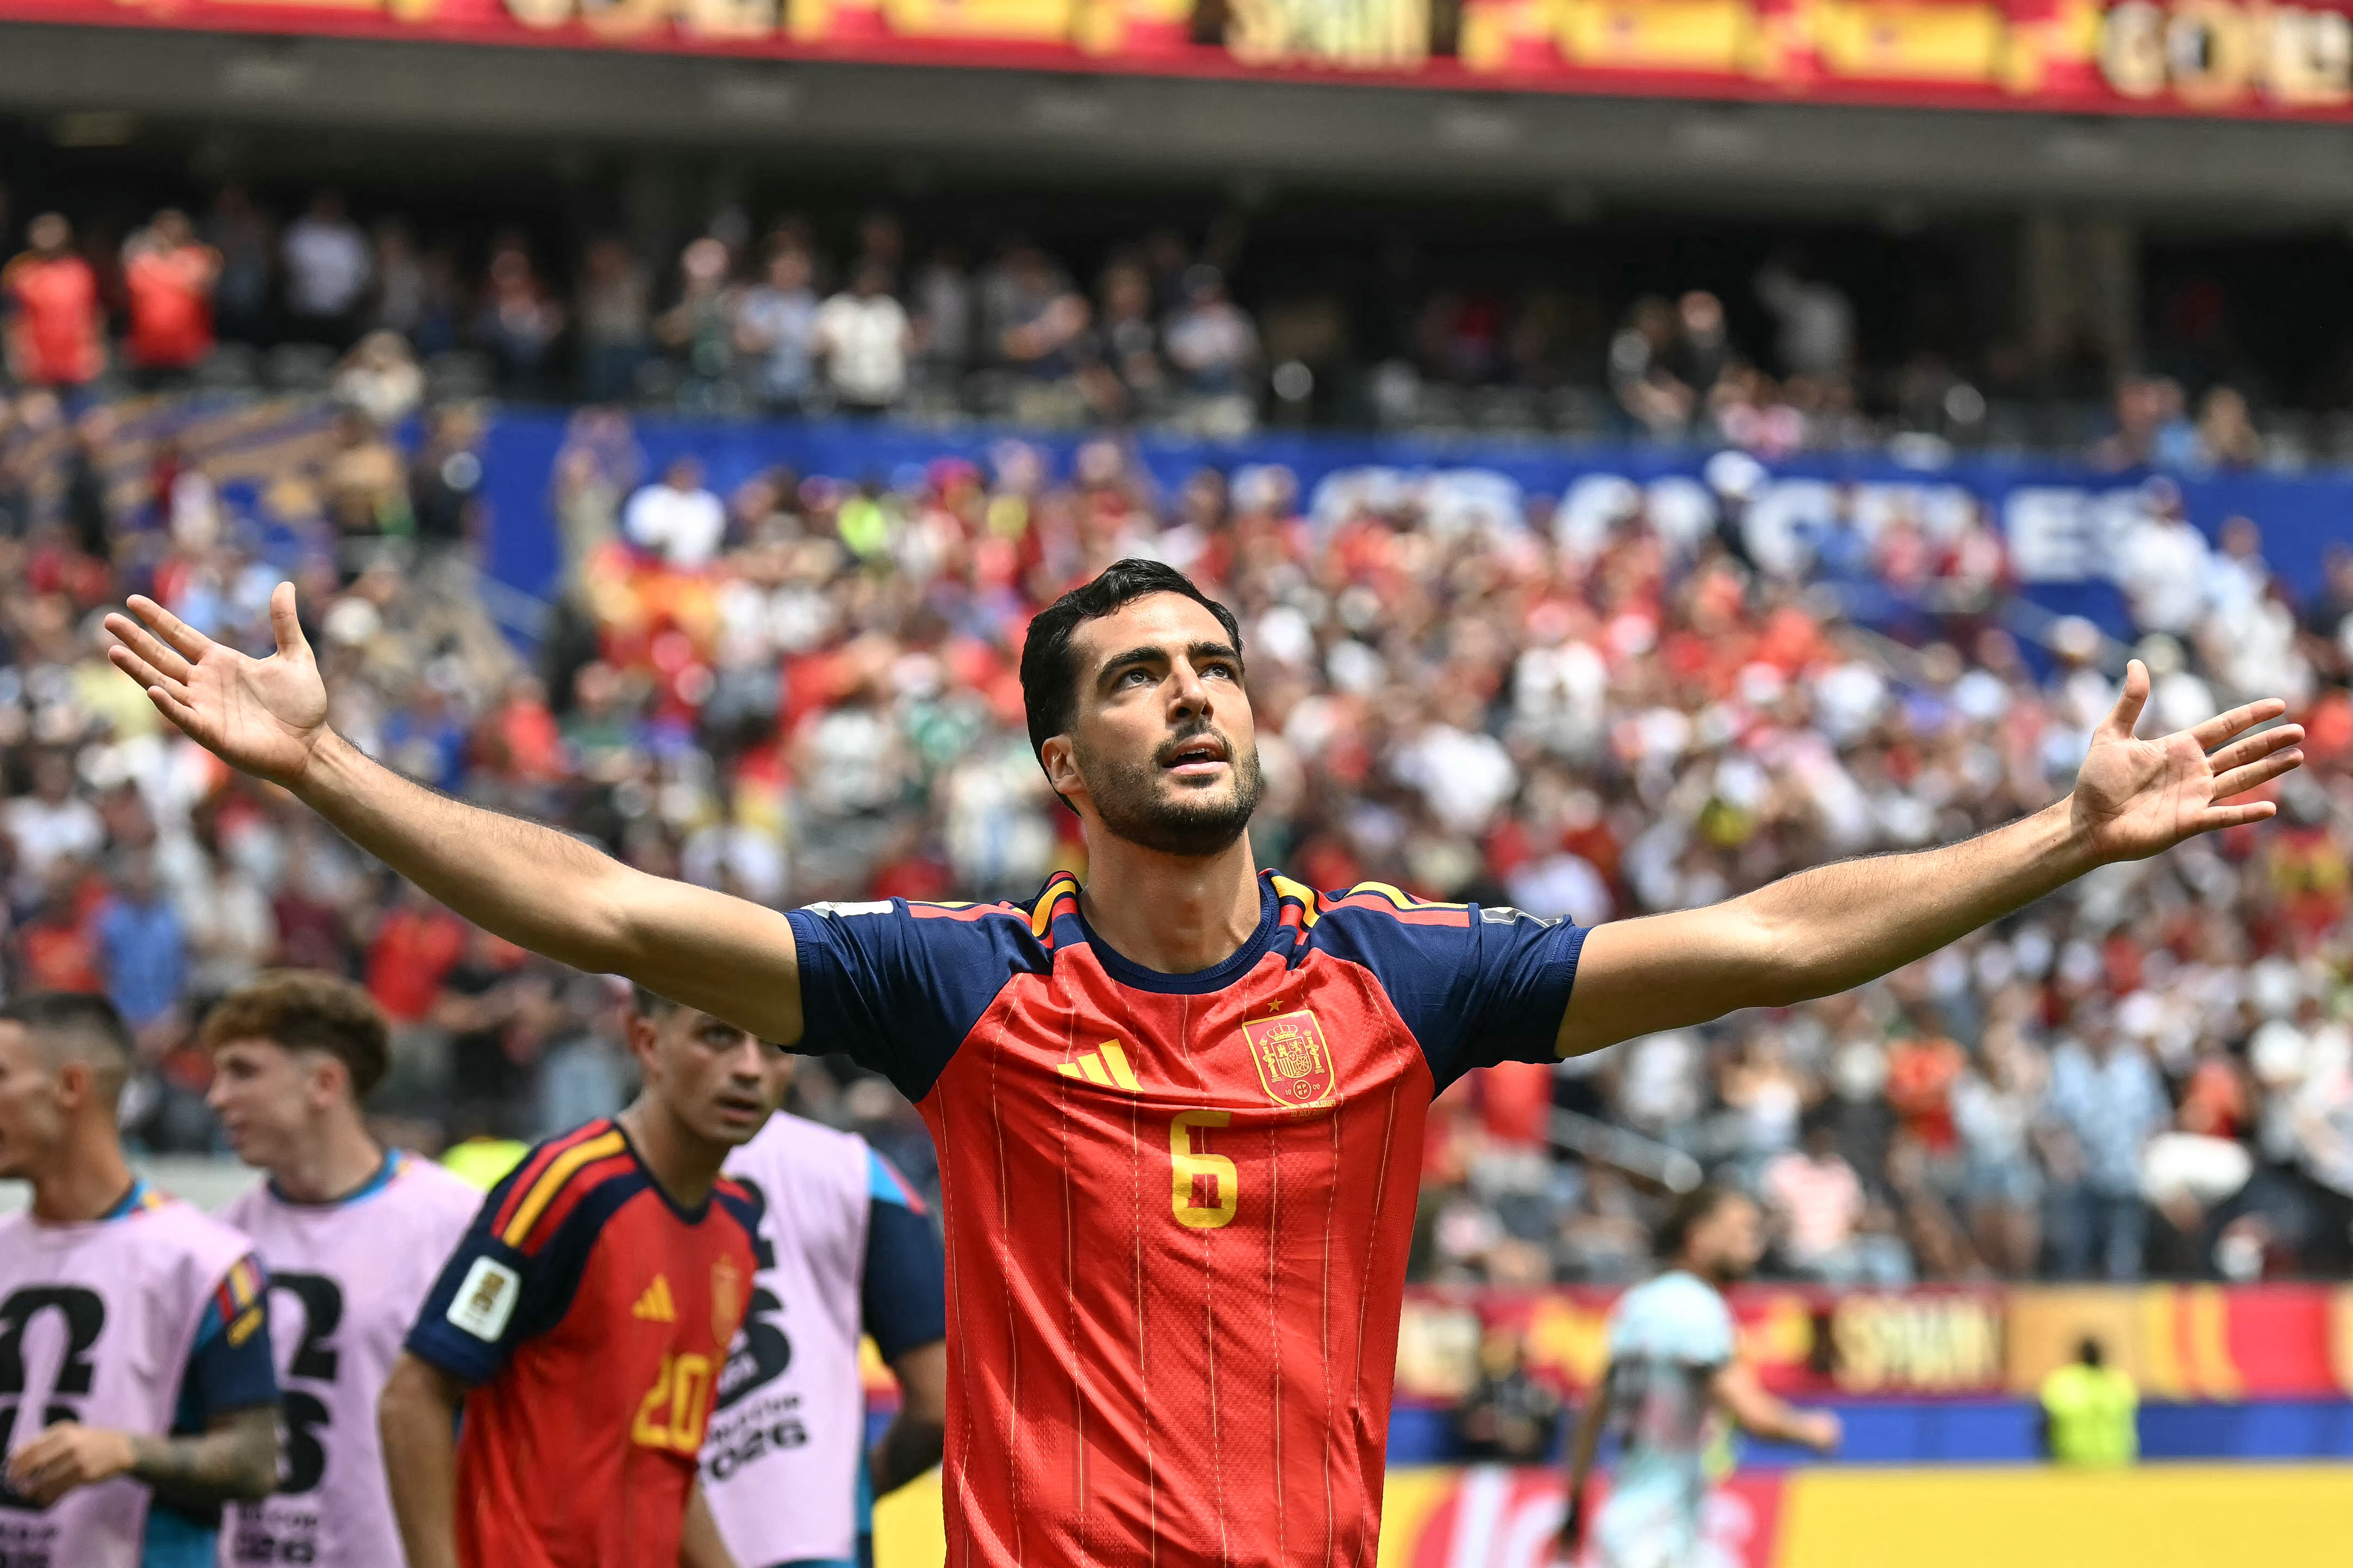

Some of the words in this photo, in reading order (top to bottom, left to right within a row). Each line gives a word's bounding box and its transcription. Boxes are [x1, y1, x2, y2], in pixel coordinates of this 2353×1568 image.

[1298, 1109, 1311, 1117] JULY
[1169, 1110, 1238, 1228] 6
[632, 1352, 710, 1453] 20
